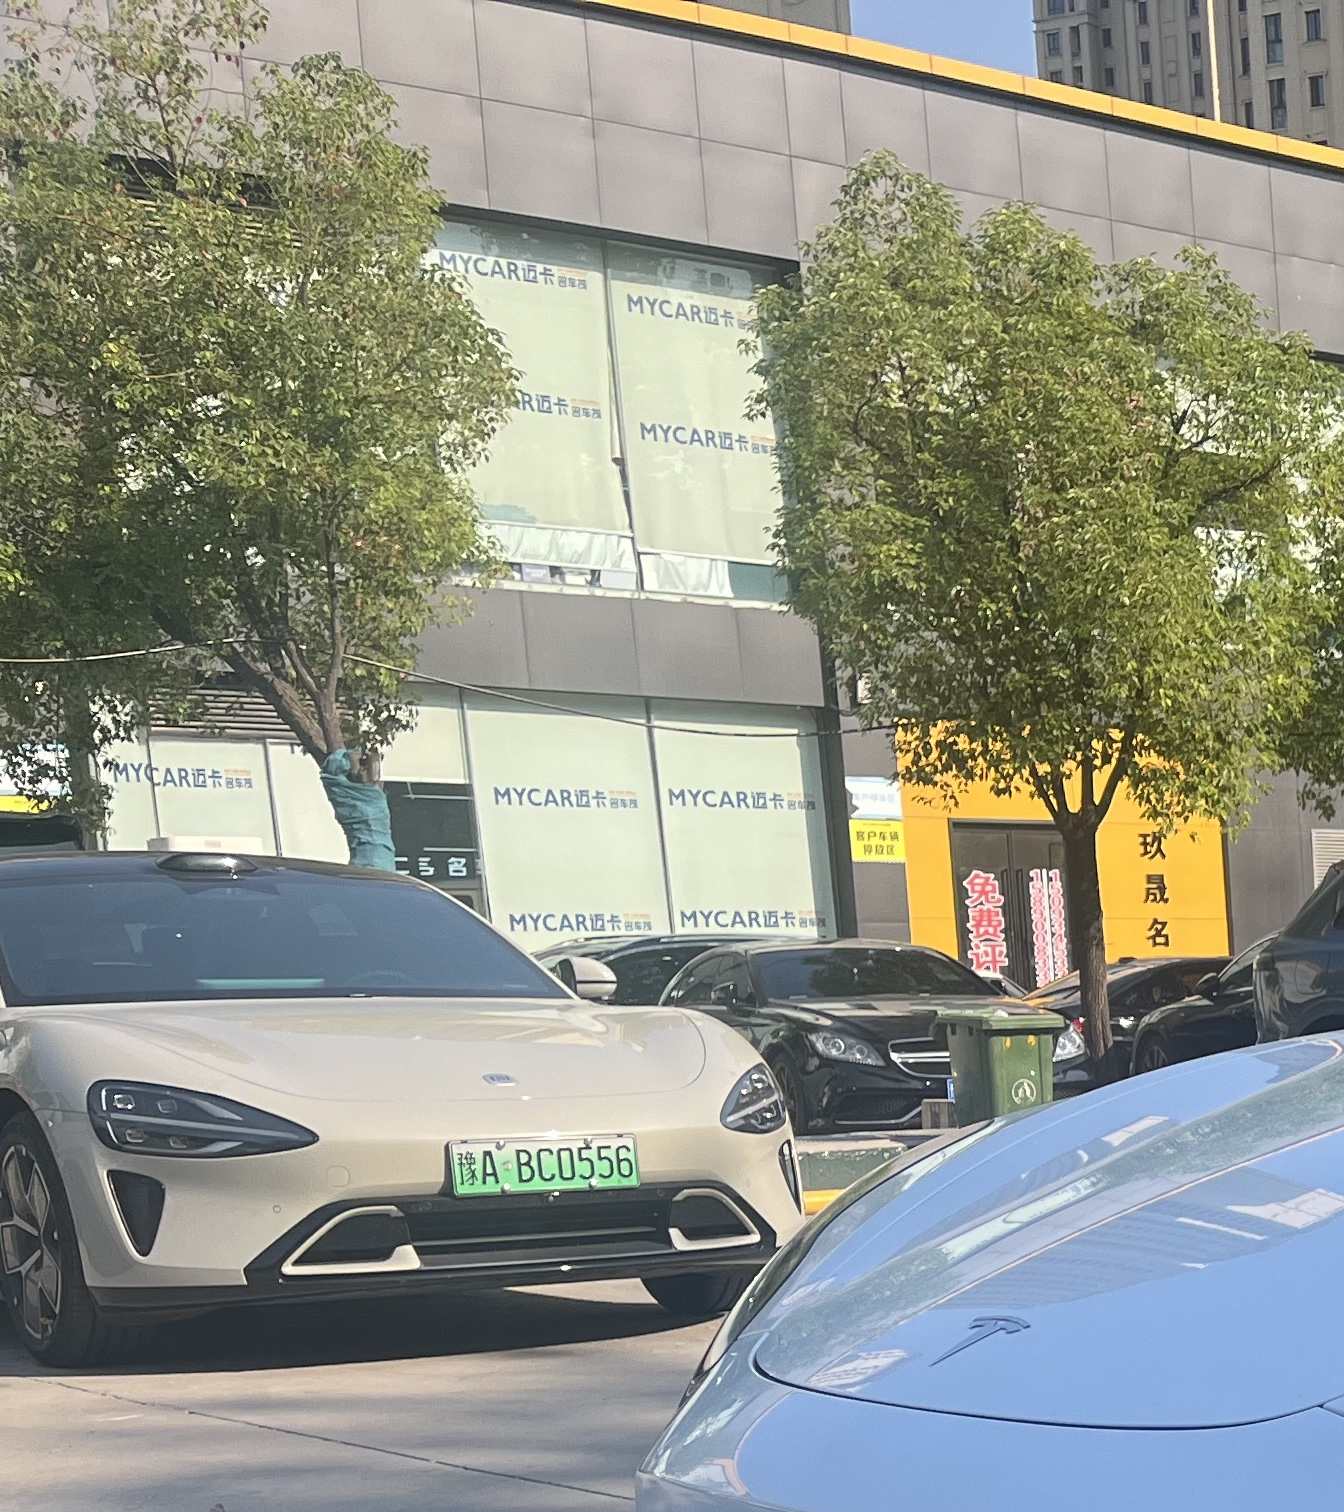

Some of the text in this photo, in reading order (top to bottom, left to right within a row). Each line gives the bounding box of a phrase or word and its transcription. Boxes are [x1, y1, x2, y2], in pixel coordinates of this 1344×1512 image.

[627, 294, 735, 328] MYCAR迈卡
[640, 422, 749, 452] MYCAR迈卡
[113, 763, 223, 788] MYCAR迈卡
[493, 786, 607, 808] MYCAR迈卡
[668, 786, 784, 810] MYCAR迈卡
[509, 913, 622, 932] MYCAR迈卡
[680, 910, 796, 928] MYCAR迈卡
